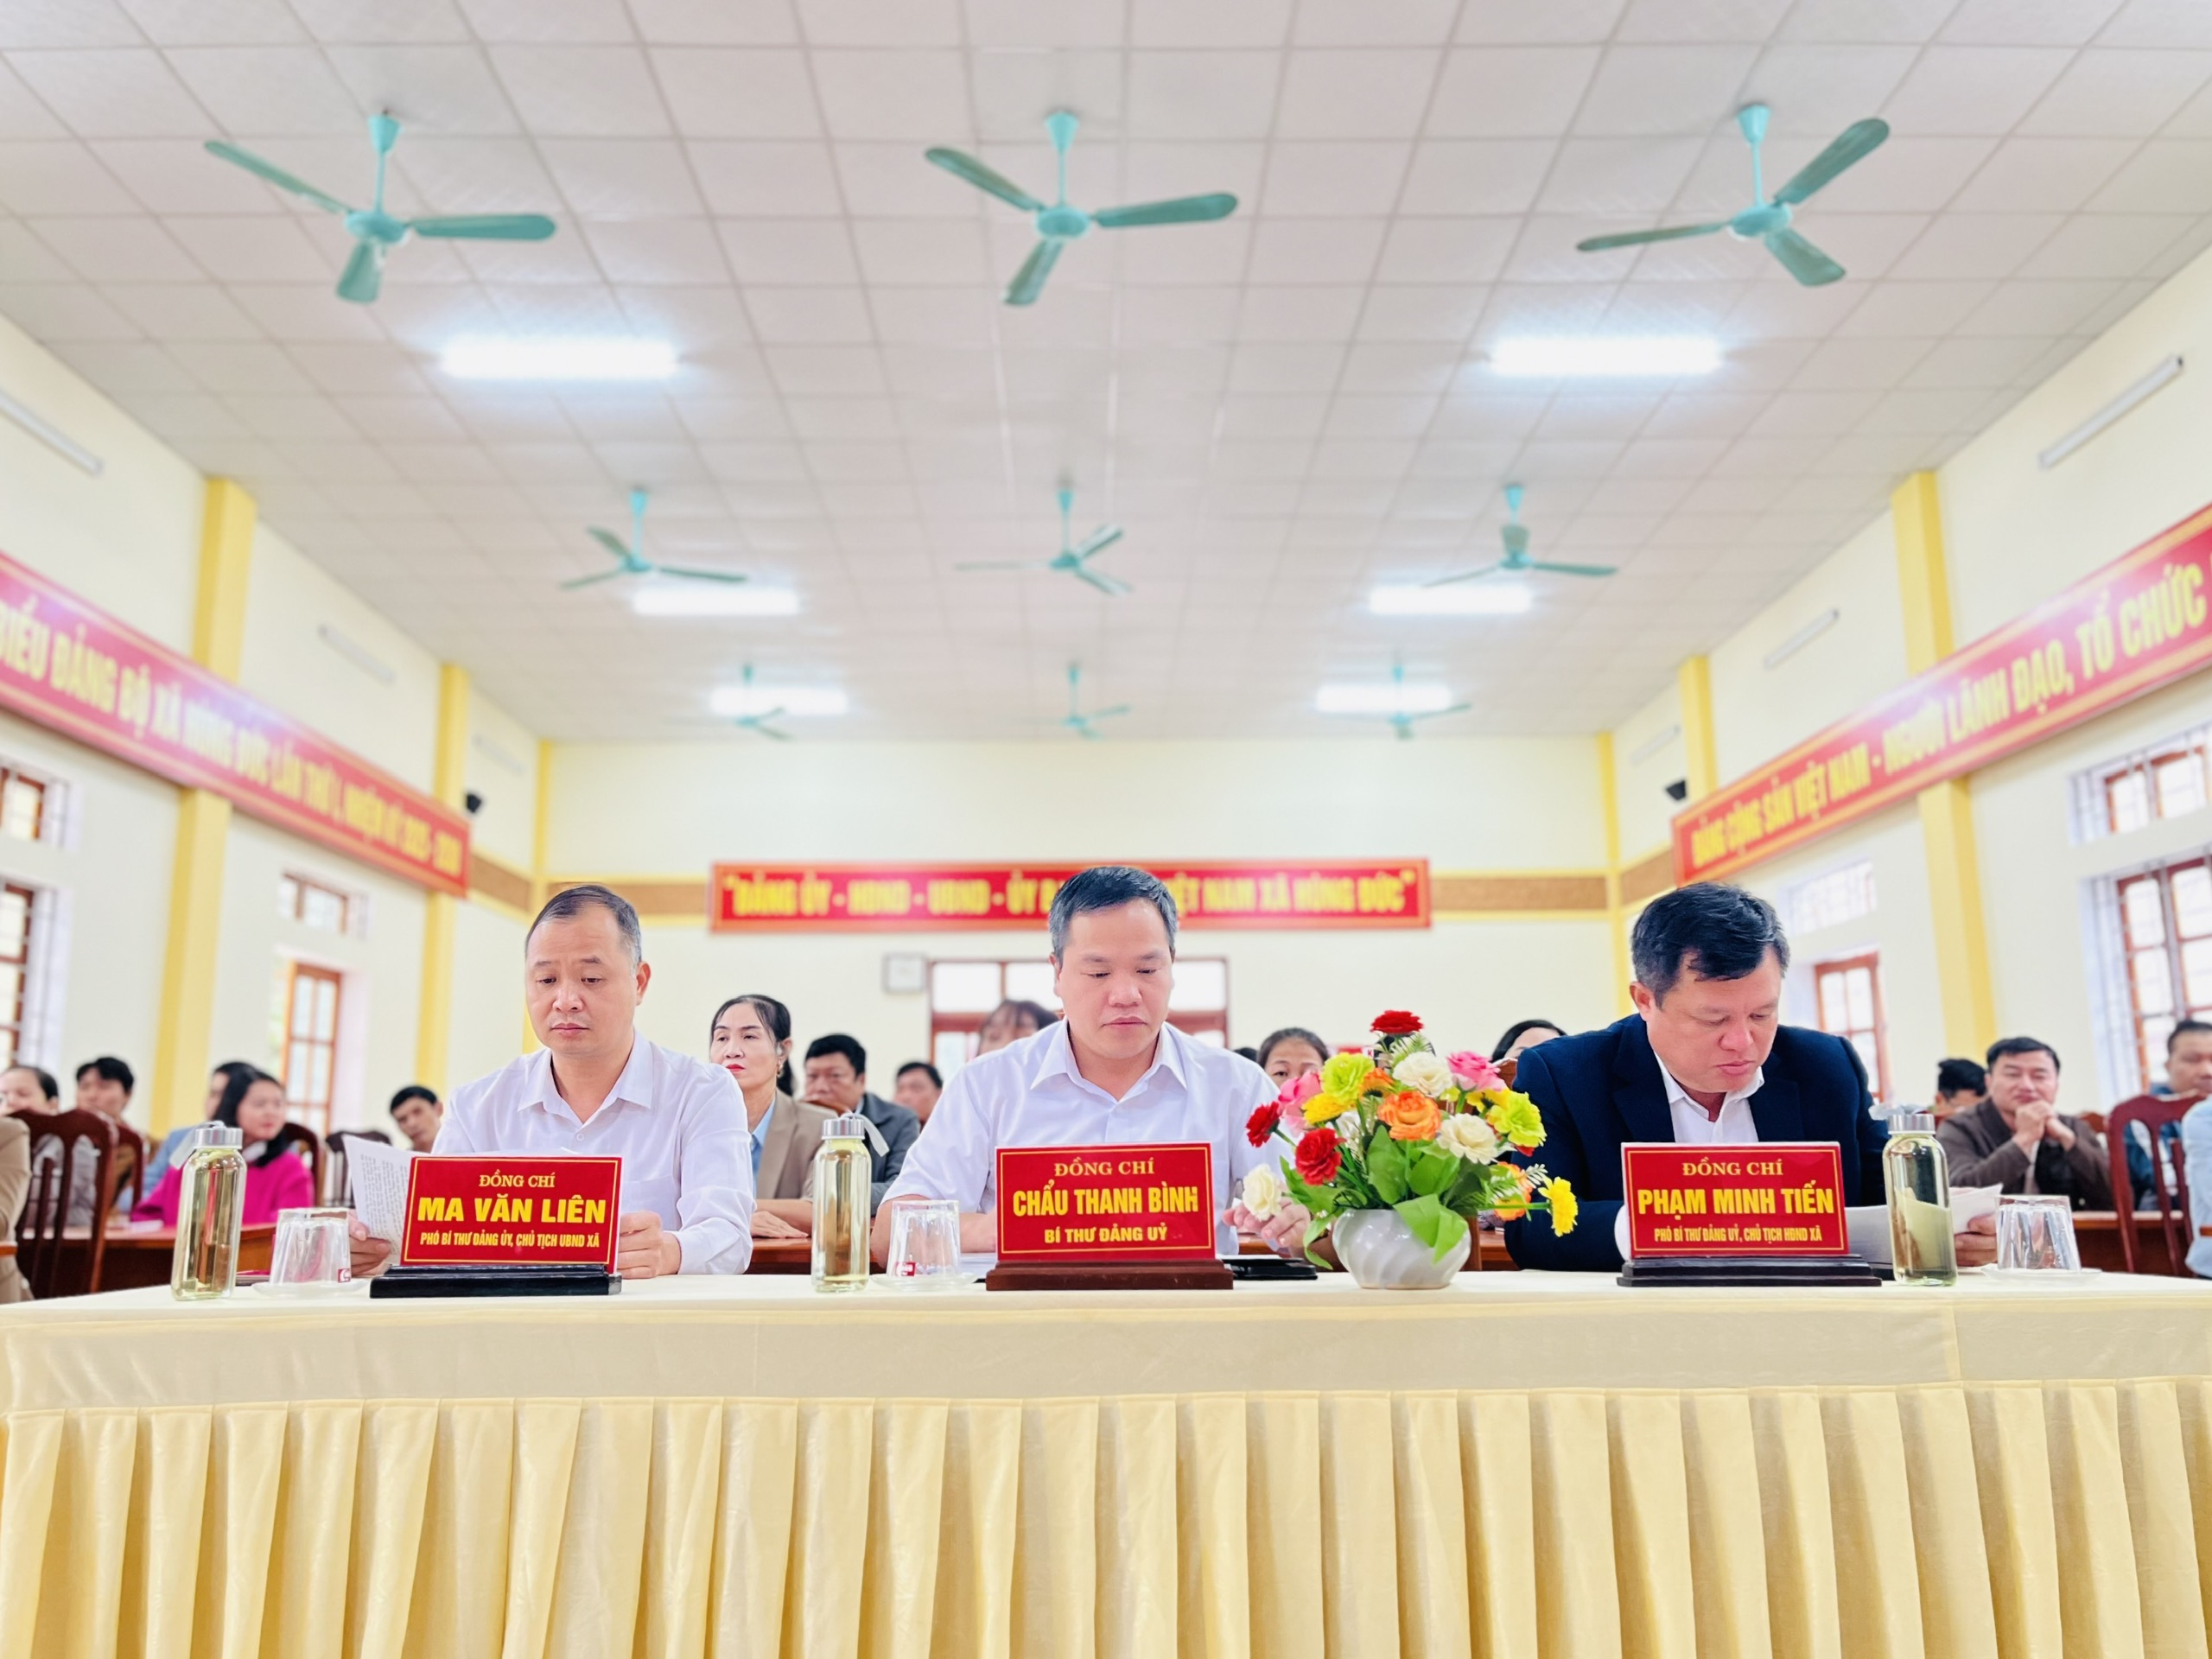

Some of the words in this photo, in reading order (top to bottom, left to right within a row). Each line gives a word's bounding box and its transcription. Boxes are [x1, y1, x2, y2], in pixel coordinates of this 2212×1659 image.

[1827, 741, 1872, 803] NAM
[1946, 677, 2011, 743] LÃNH
[2011, 639, 2075, 715] ĐẠO,
[2119, 563, 2208, 659] CHỨC
[1053, 1156, 1112, 1176] ĐỒNG
[1118, 1157, 1155, 1175] CHÍ
[1682, 1156, 1741, 1176] ĐỒNG
[1746, 1159, 1783, 1175] CHÍ
[479, 1169, 524, 1188] ĐỒNG
[528, 1172, 556, 1188] CHÍ
[417, 1197, 465, 1221] MA
[474, 1193, 533, 1223] VĂN
[541, 1194, 607, 1224] LIÊN
[1013, 1179, 1069, 1217] CHẨU
[1074, 1187, 1143, 1215] THANH
[1148, 1180, 1199, 1213] BÌNH
[1637, 1188, 1707, 1221] PHẠM
[1713, 1188, 1777, 1215] MINH
[1780, 1179, 1834, 1214] TIẾN
[420, 1230, 440, 1245] PHÓ
[441, 1230, 452, 1245] BÍ
[454, 1231, 473, 1246] THƯ
[499, 1229, 514, 1248] ỦY,
[516, 1230, 536, 1247] CHỦ
[537, 1234, 558, 1249] TỊCH
[559, 1234, 586, 1248] UBND
[587, 1232, 601, 1248] XÃ
[1044, 1226, 1061, 1243] BÍ
[1065, 1227, 1096, 1243] THƯ
[1099, 1223, 1143, 1243] ĐẢNG
[1147, 1222, 1168, 1241] UỶ
[1654, 1225, 1673, 1243] PHÓ
[1673, 1225, 1684, 1242] BÍ
[1684, 1226, 1702, 1242] THƯ
[1743, 1223, 1762, 1243] CHỦ
[1763, 1227, 1783, 1244] TỊCH
[1809, 1224, 1823, 1242] XÃ
